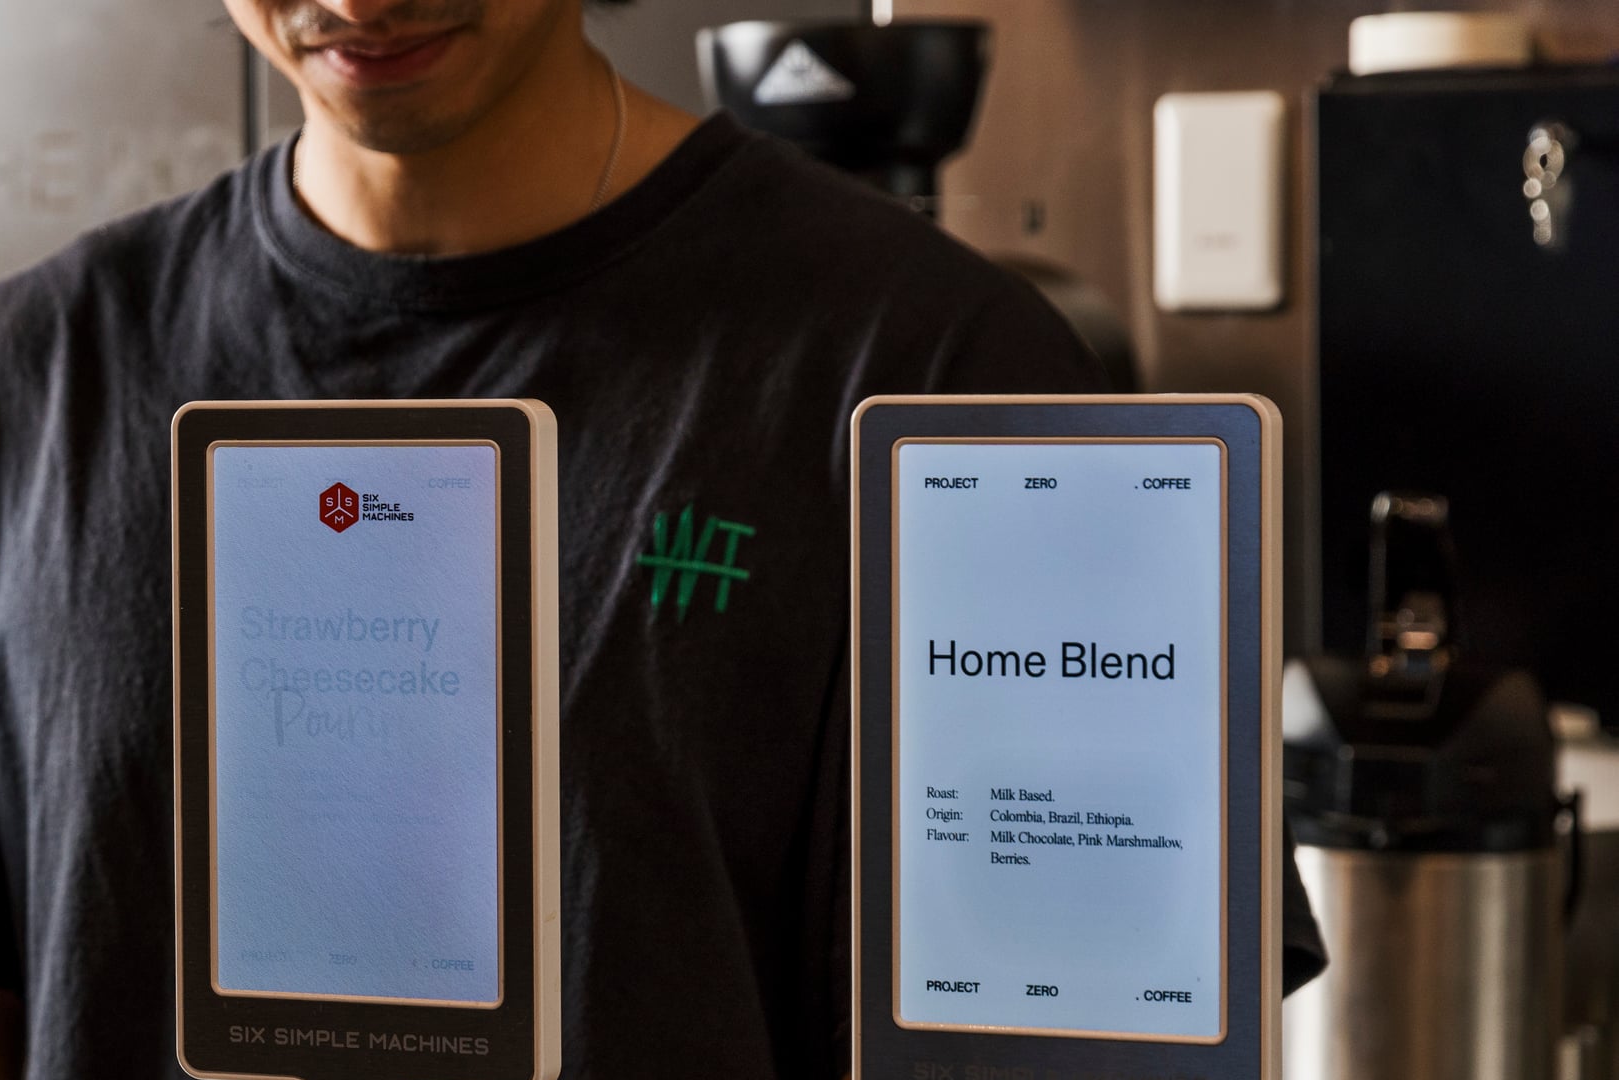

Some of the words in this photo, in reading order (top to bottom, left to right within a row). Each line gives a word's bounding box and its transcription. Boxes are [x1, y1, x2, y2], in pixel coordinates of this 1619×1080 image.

[428, 477, 471, 489] COFFEE
[924, 477, 979, 490] PROJECT
[1024, 478, 1058, 490] ZERO
[1142, 478, 1192, 491] COFFEE
[362, 494, 379, 502] SIX
[362, 503, 400, 512] SIMPLE
[362, 512, 414, 522] MACHINES
[240, 605, 441, 652] Strawberry
[927, 639, 1047, 679] Home
[1061, 641, 1177, 681] Blend
[240, 656, 461, 697] Cheesecake
[926, 787, 959, 799] Roast:
[990, 788, 1016, 801] Milk
[1018, 789, 1055, 802] Based.
[926, 808, 964, 823] Origin:
[990, 810, 1046, 825] Colombia,
[1048, 811, 1084, 826] Brazil,
[1086, 812, 1135, 828] Ethiopia.
[926, 829, 970, 842] Flavour:
[990, 830, 1016, 844] Milk
[1018, 832, 1075, 847] Chocolate,
[1078, 833, 1103, 847] Pink
[1106, 835, 1183, 850] Marshmallow,
[990, 852, 1031, 865] Berries.
[431, 959, 475, 972] COFFEE
[926, 980, 981, 995] PROJECT
[1026, 984, 1059, 998] ZERO
[1143, 989, 1193, 1004] COFFEE
[228, 1025, 266, 1044] SIX
[274, 1028, 360, 1049] SIMPLE
[368, 1033, 490, 1056] MACHINES
